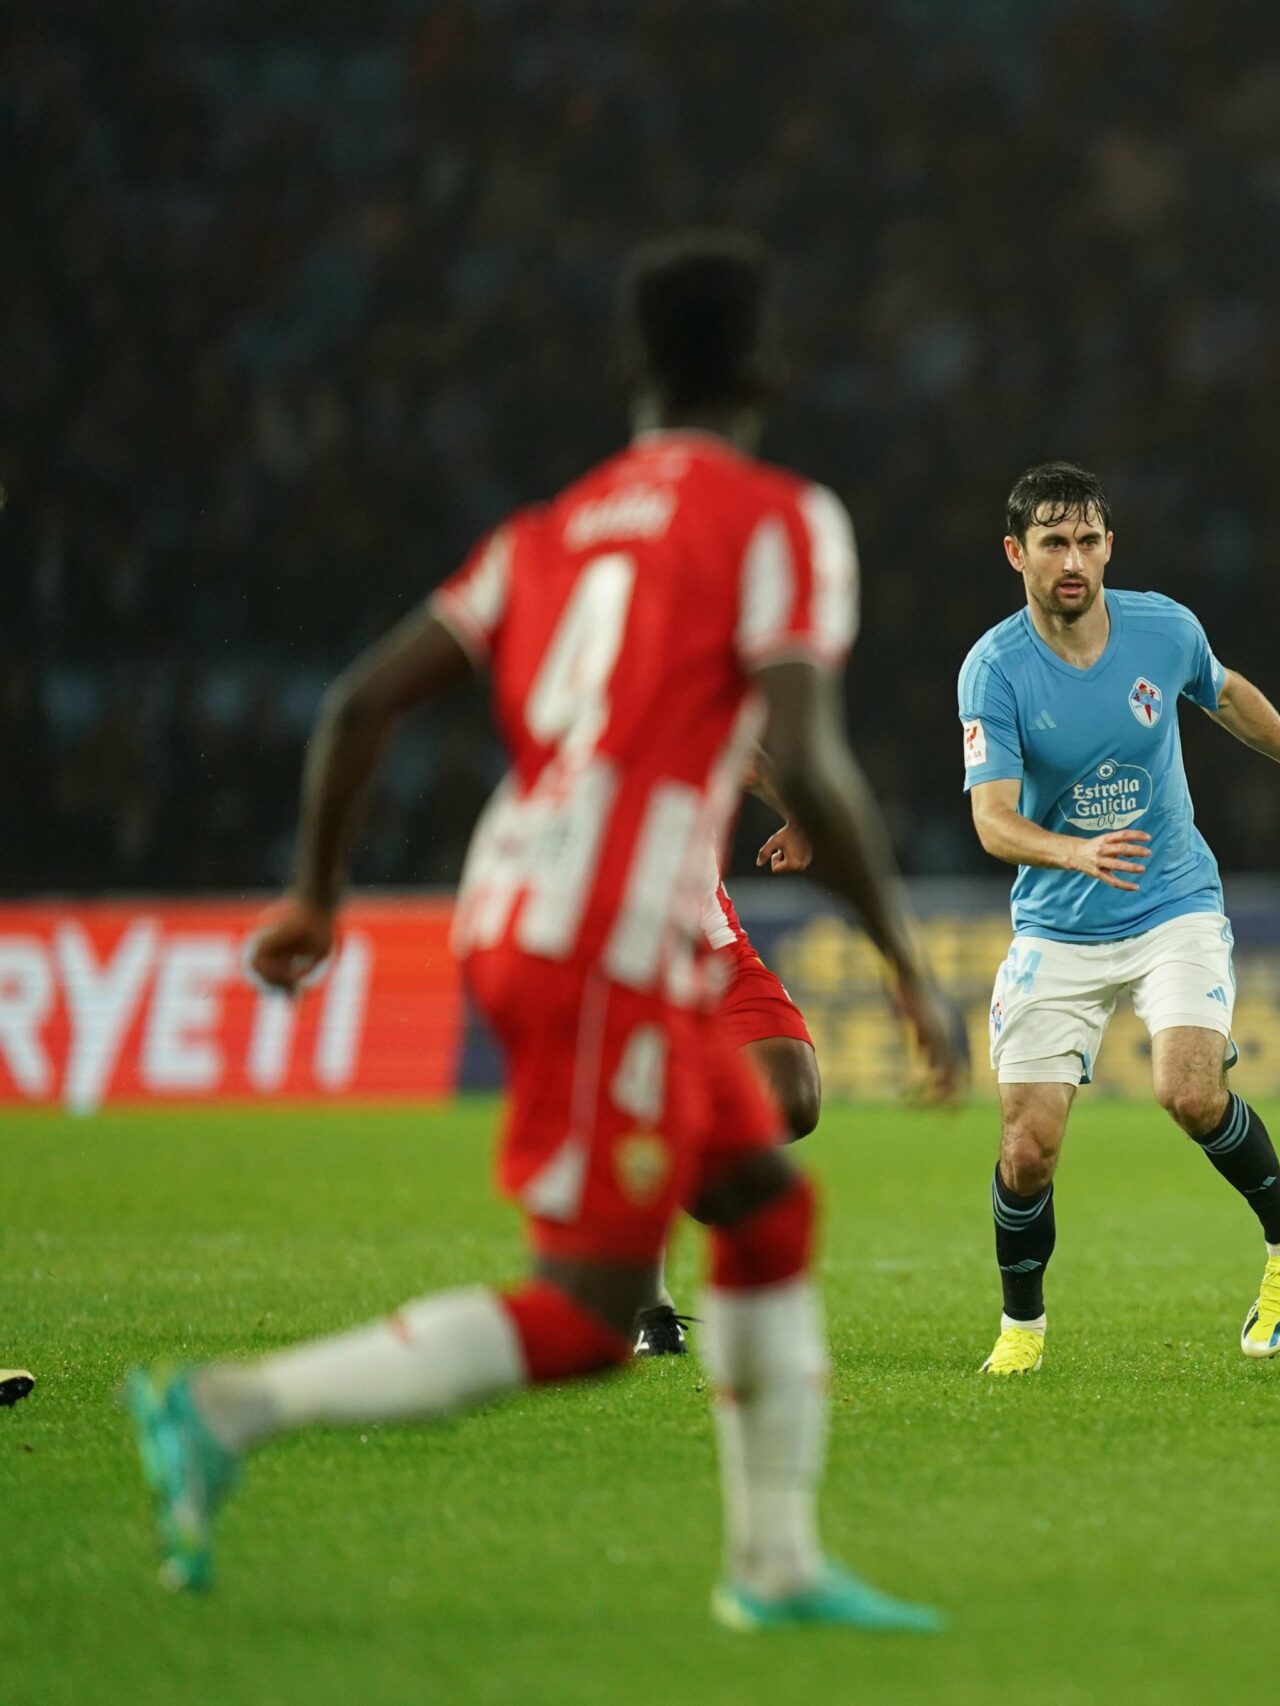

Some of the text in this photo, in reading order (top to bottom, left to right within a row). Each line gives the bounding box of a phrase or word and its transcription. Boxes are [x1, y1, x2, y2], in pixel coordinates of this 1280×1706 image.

[526, 550, 636, 772] 4
[1072, 778, 1140, 800] Estrella
[1075, 795, 1137, 816] Galicia
[611, 1024, 669, 1125] 4
